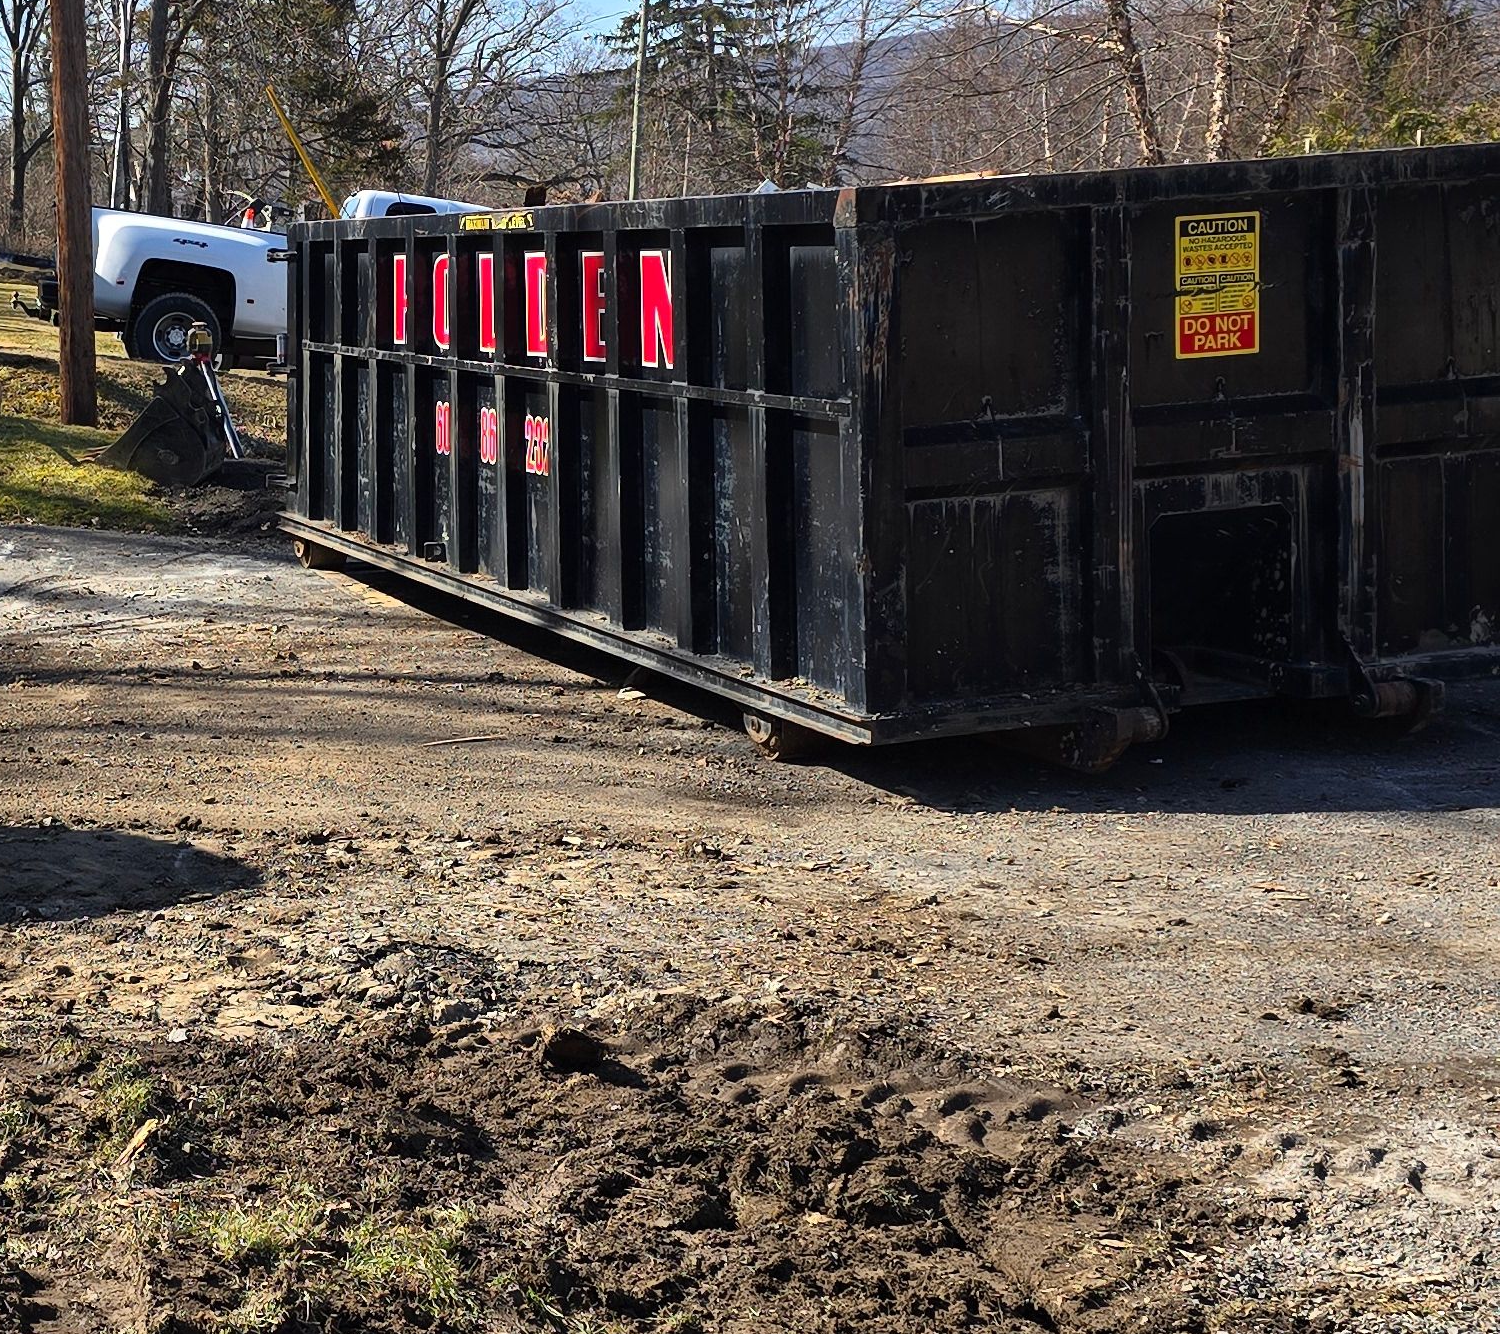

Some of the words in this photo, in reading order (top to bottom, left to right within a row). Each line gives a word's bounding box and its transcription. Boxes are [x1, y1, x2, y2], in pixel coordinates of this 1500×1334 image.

[1187, 219, 1248, 235] CAUTION
[1188, 237, 1200, 245] NO
[1201, 234, 1247, 244] HAZARDOUS
[1182, 244, 1213, 253] WASTES
[1214, 242, 1253, 251] ACCEPTED
[1181, 275, 1216, 285] CAUTION
[1220, 273, 1254, 283] CAUTION
[1184, 318, 1210, 335] DO
[1215, 314, 1252, 332] NOT
[1194, 332, 1242, 351] PARK
